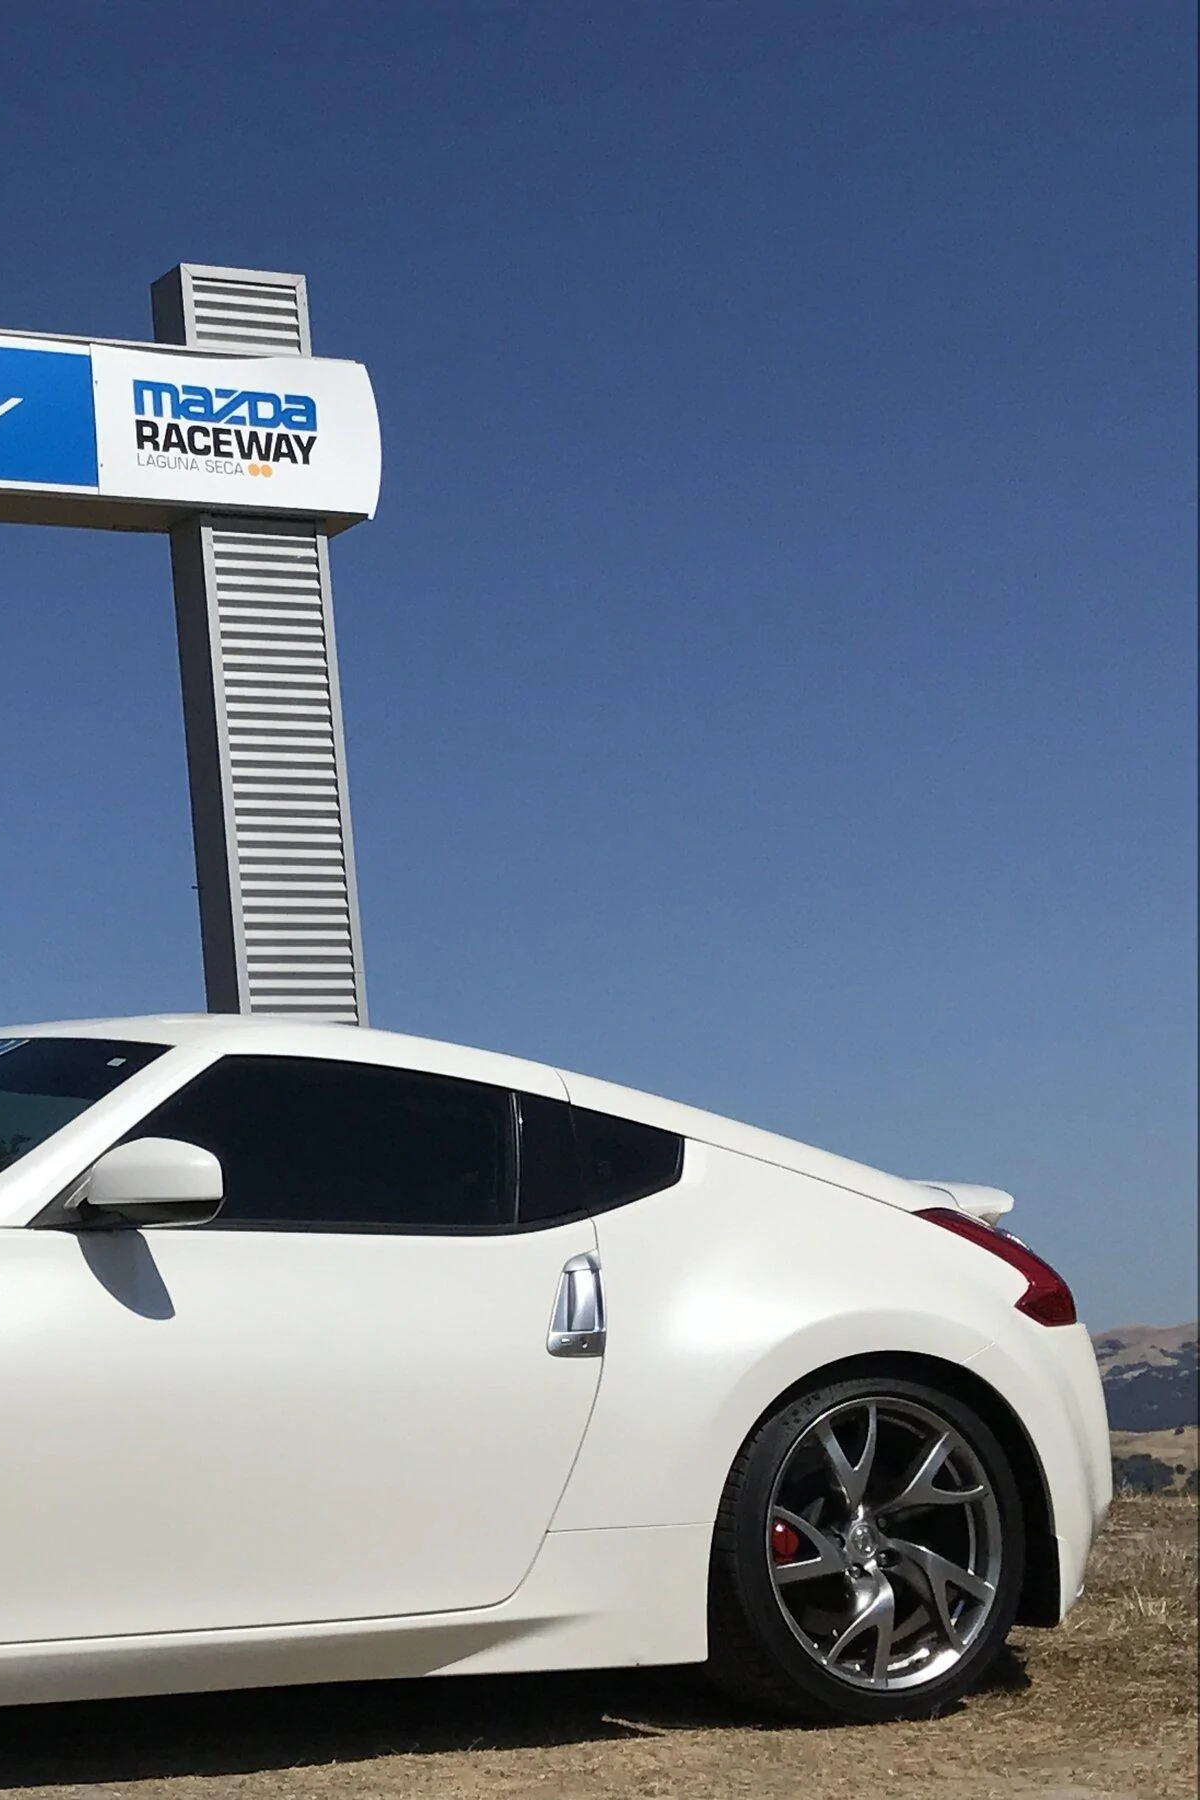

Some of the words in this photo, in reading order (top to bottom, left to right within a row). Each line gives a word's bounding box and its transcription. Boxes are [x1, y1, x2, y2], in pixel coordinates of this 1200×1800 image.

[135, 419, 317, 465] RACEWAY
[137, 452, 200, 473] LAGUNA
[205, 459, 245, 476] SECA
